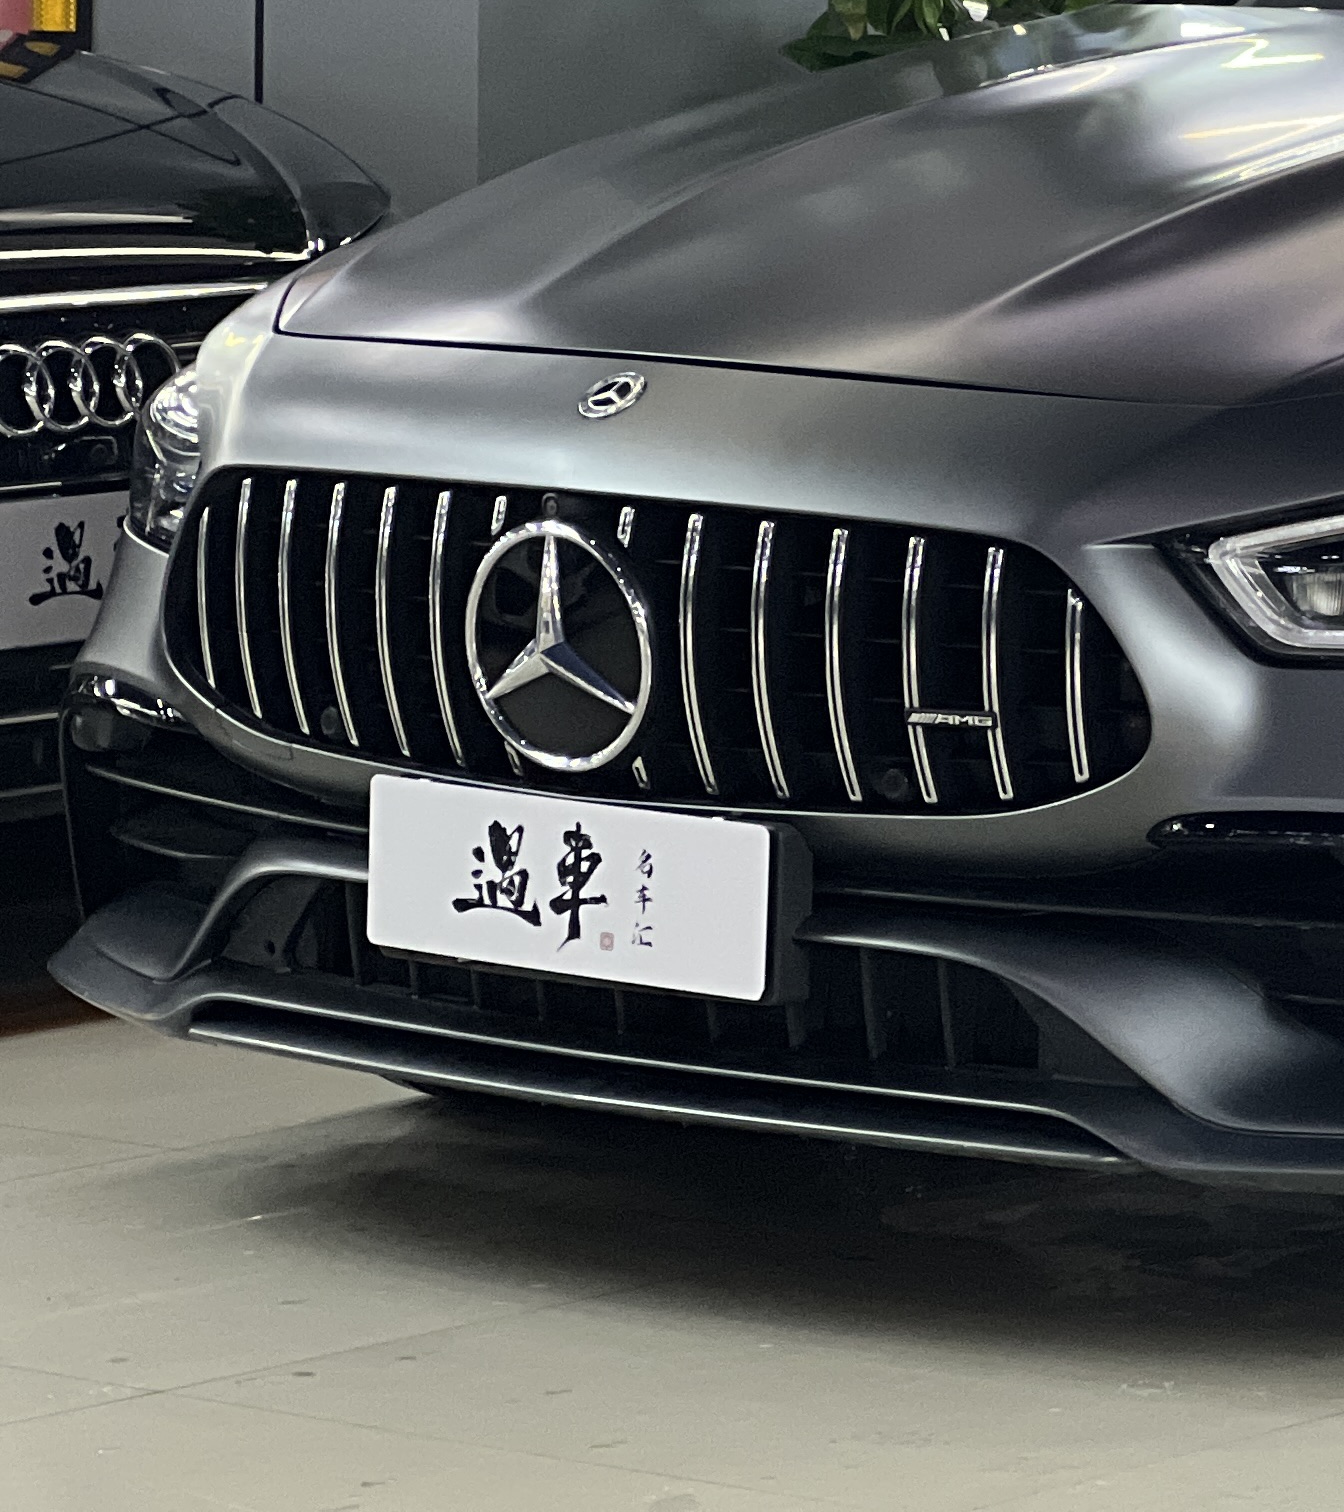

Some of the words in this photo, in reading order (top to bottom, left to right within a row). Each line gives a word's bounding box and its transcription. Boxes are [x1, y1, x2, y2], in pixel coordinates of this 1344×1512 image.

[934, 713, 993, 727] AMG
[631, 848, 654, 949] 名车汇
